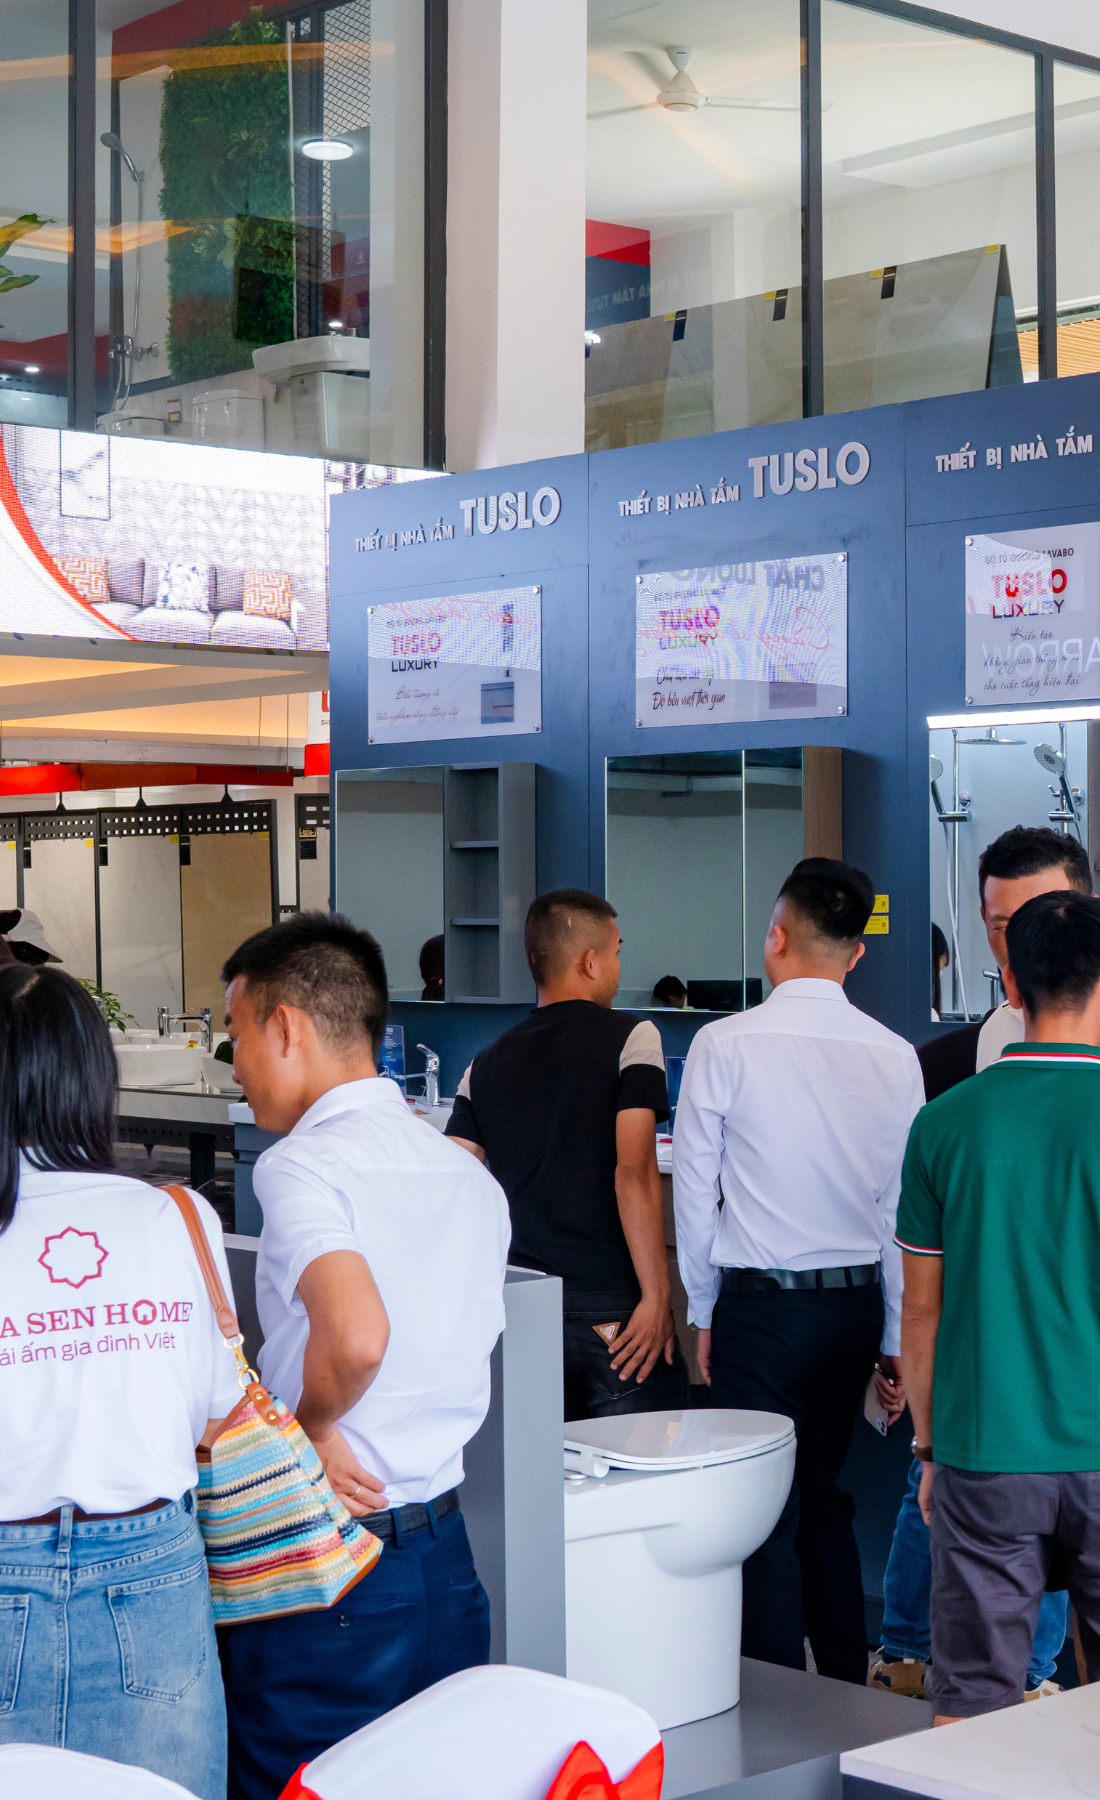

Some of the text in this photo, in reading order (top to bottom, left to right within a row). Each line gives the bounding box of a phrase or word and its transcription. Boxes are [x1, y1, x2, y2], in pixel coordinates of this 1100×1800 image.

[935, 441, 977, 473] THIẾT
[986, 447, 1002, 470] BỊ
[1010, 434, 1048, 463] NHÀ
[1056, 425, 1093, 457] TẮM
[618, 441, 871, 517] THIẾT BỊ NHÀ TẮM TUSLO
[355, 528, 382, 552] THIẾT
[400, 523, 427, 546] NHÀ
[430, 517, 455, 542] TẮM
[460, 487, 562, 537] TUSLO
[992, 569, 1068, 599] TUSLO
[659, 605, 720, 632] TUSLO
[391, 632, 442, 656] TUSLO
[984, 678, 998, 691] cho
[652, 692, 666, 710] Độ
[26, 1306, 96, 1335] SEN
[103, 1299, 193, 1326] HOME
[21, 1342, 57, 1363] ấm
[61, 1340, 92, 1361] gia
[97, 1333, 140, 1353] đình
[144, 1331, 176, 1353] Việt
